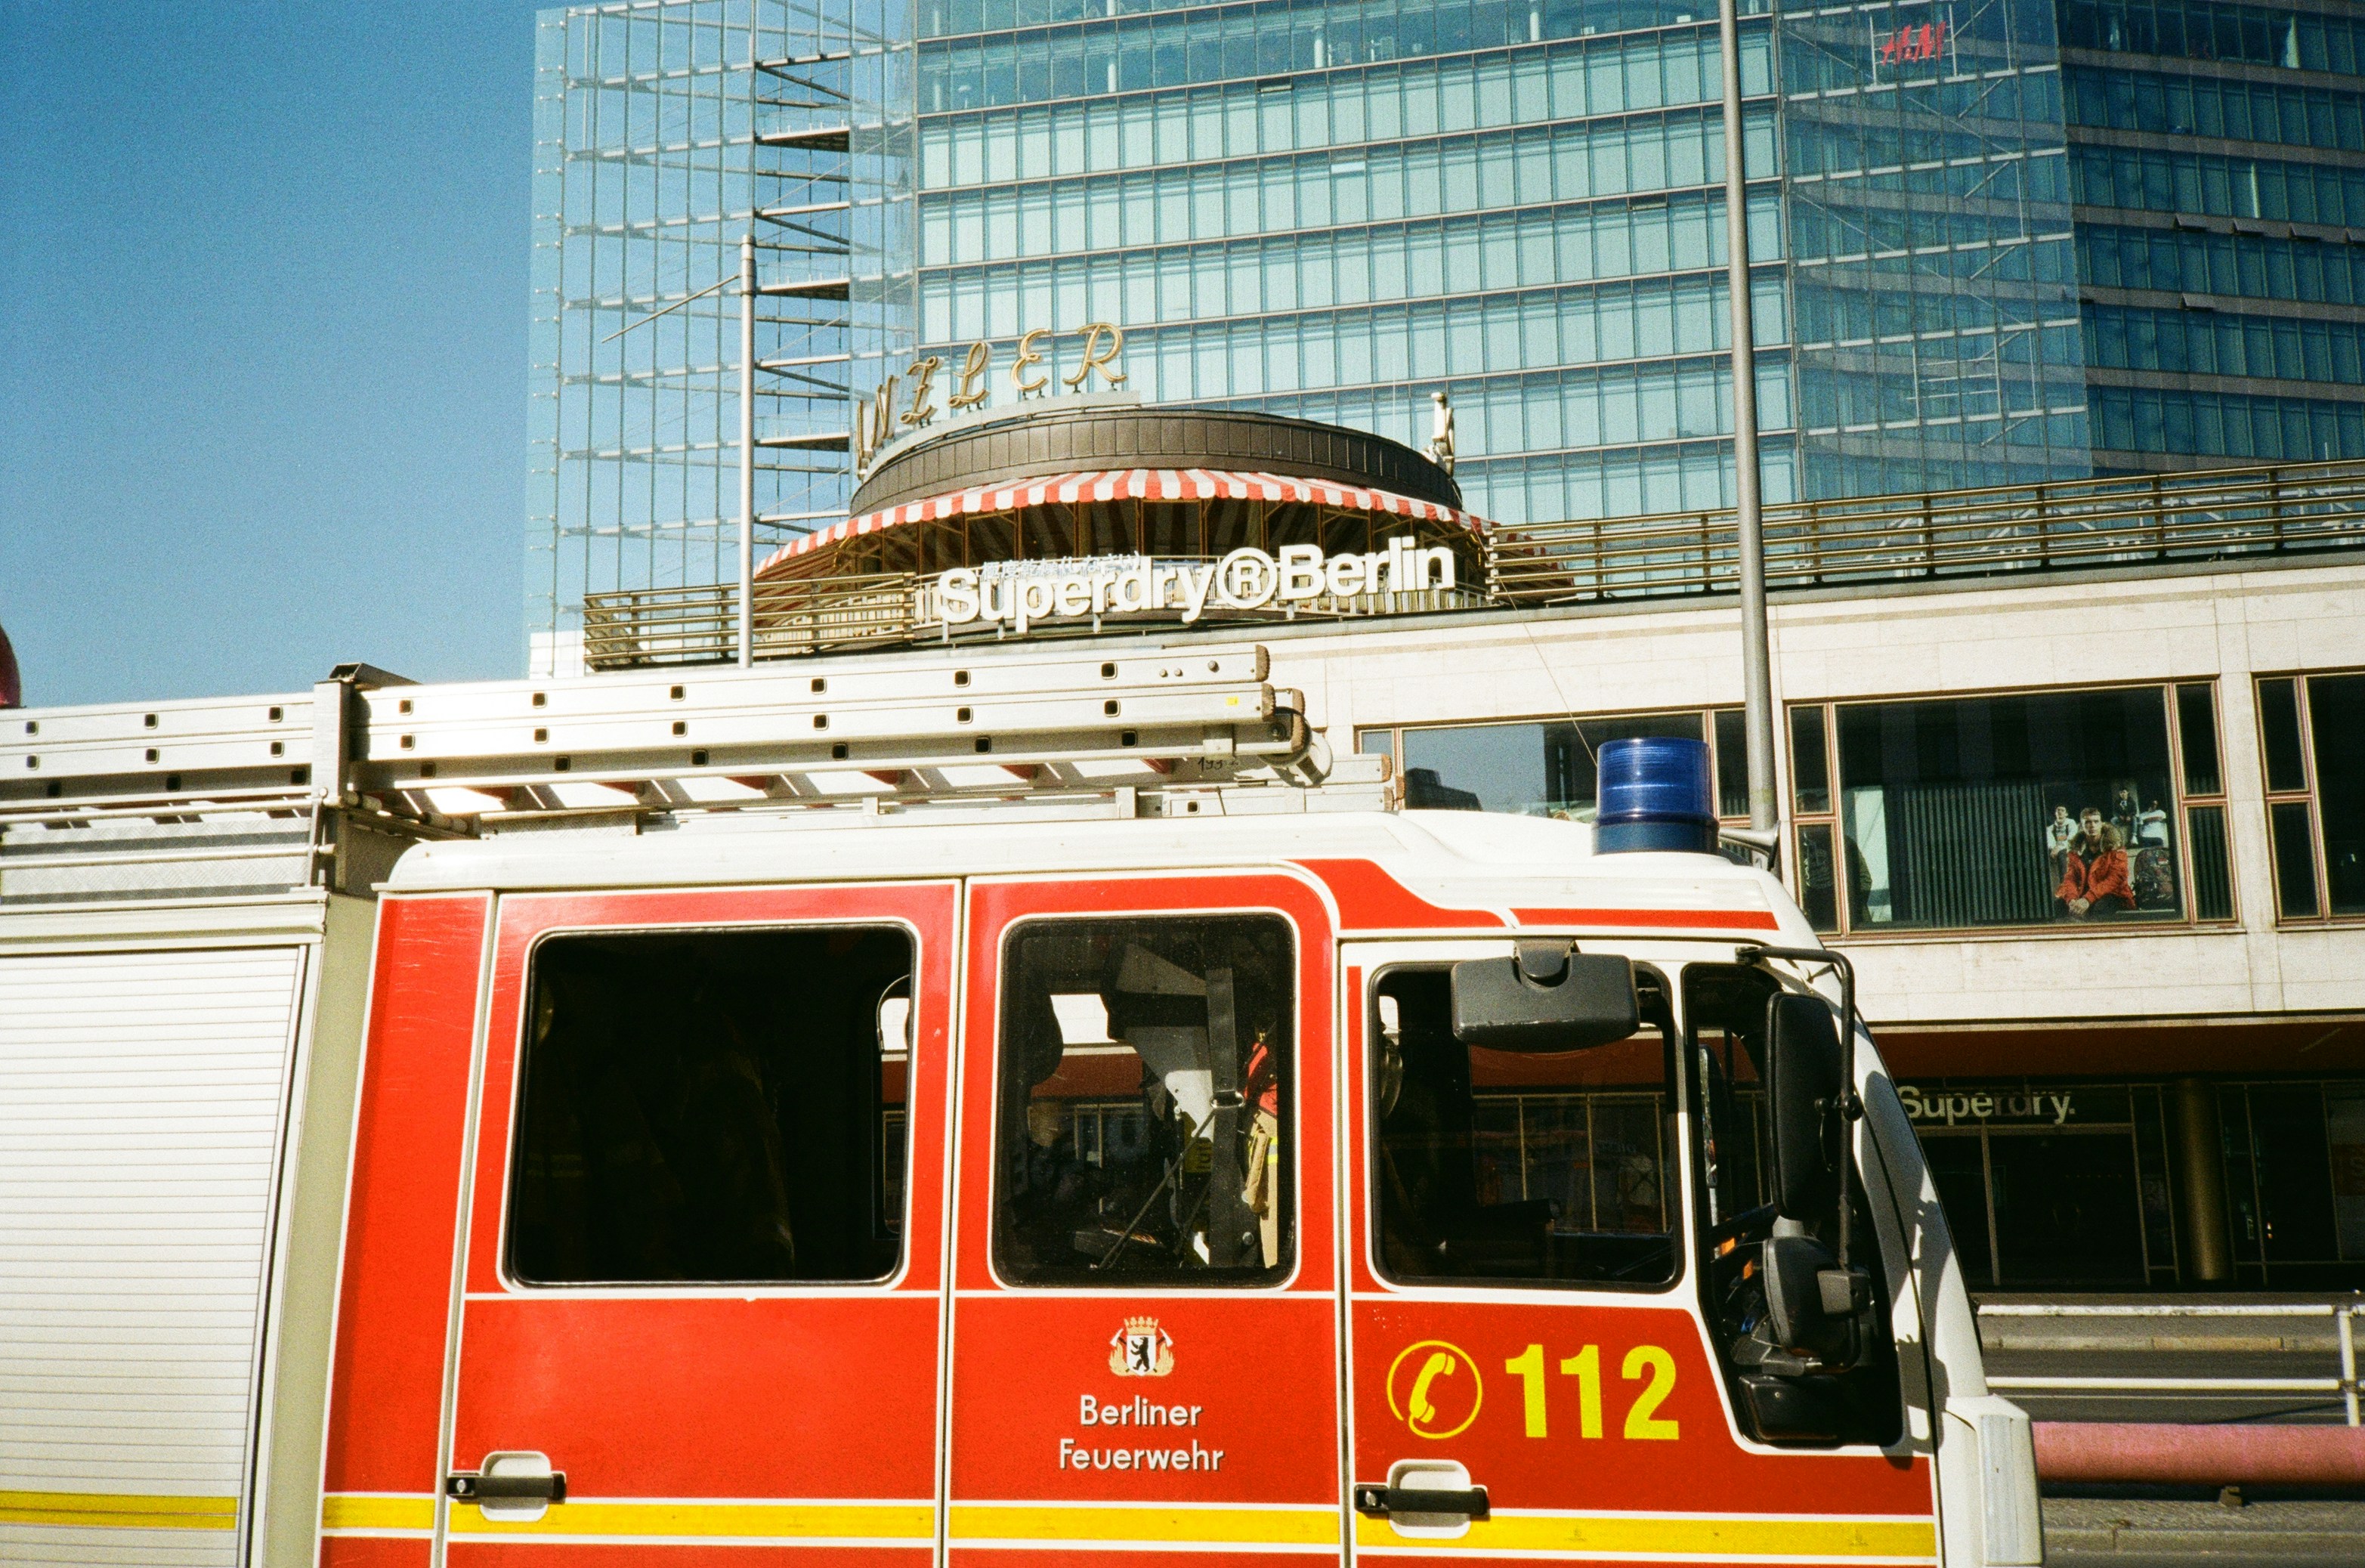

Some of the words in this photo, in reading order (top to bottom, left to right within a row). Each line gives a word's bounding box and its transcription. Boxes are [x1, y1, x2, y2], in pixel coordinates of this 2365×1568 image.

[1505, 1344, 1680, 1440] 112
[1080, 1394, 1203, 1427] Berliner
[1059, 1437, 1225, 1471] Feuerwehr
